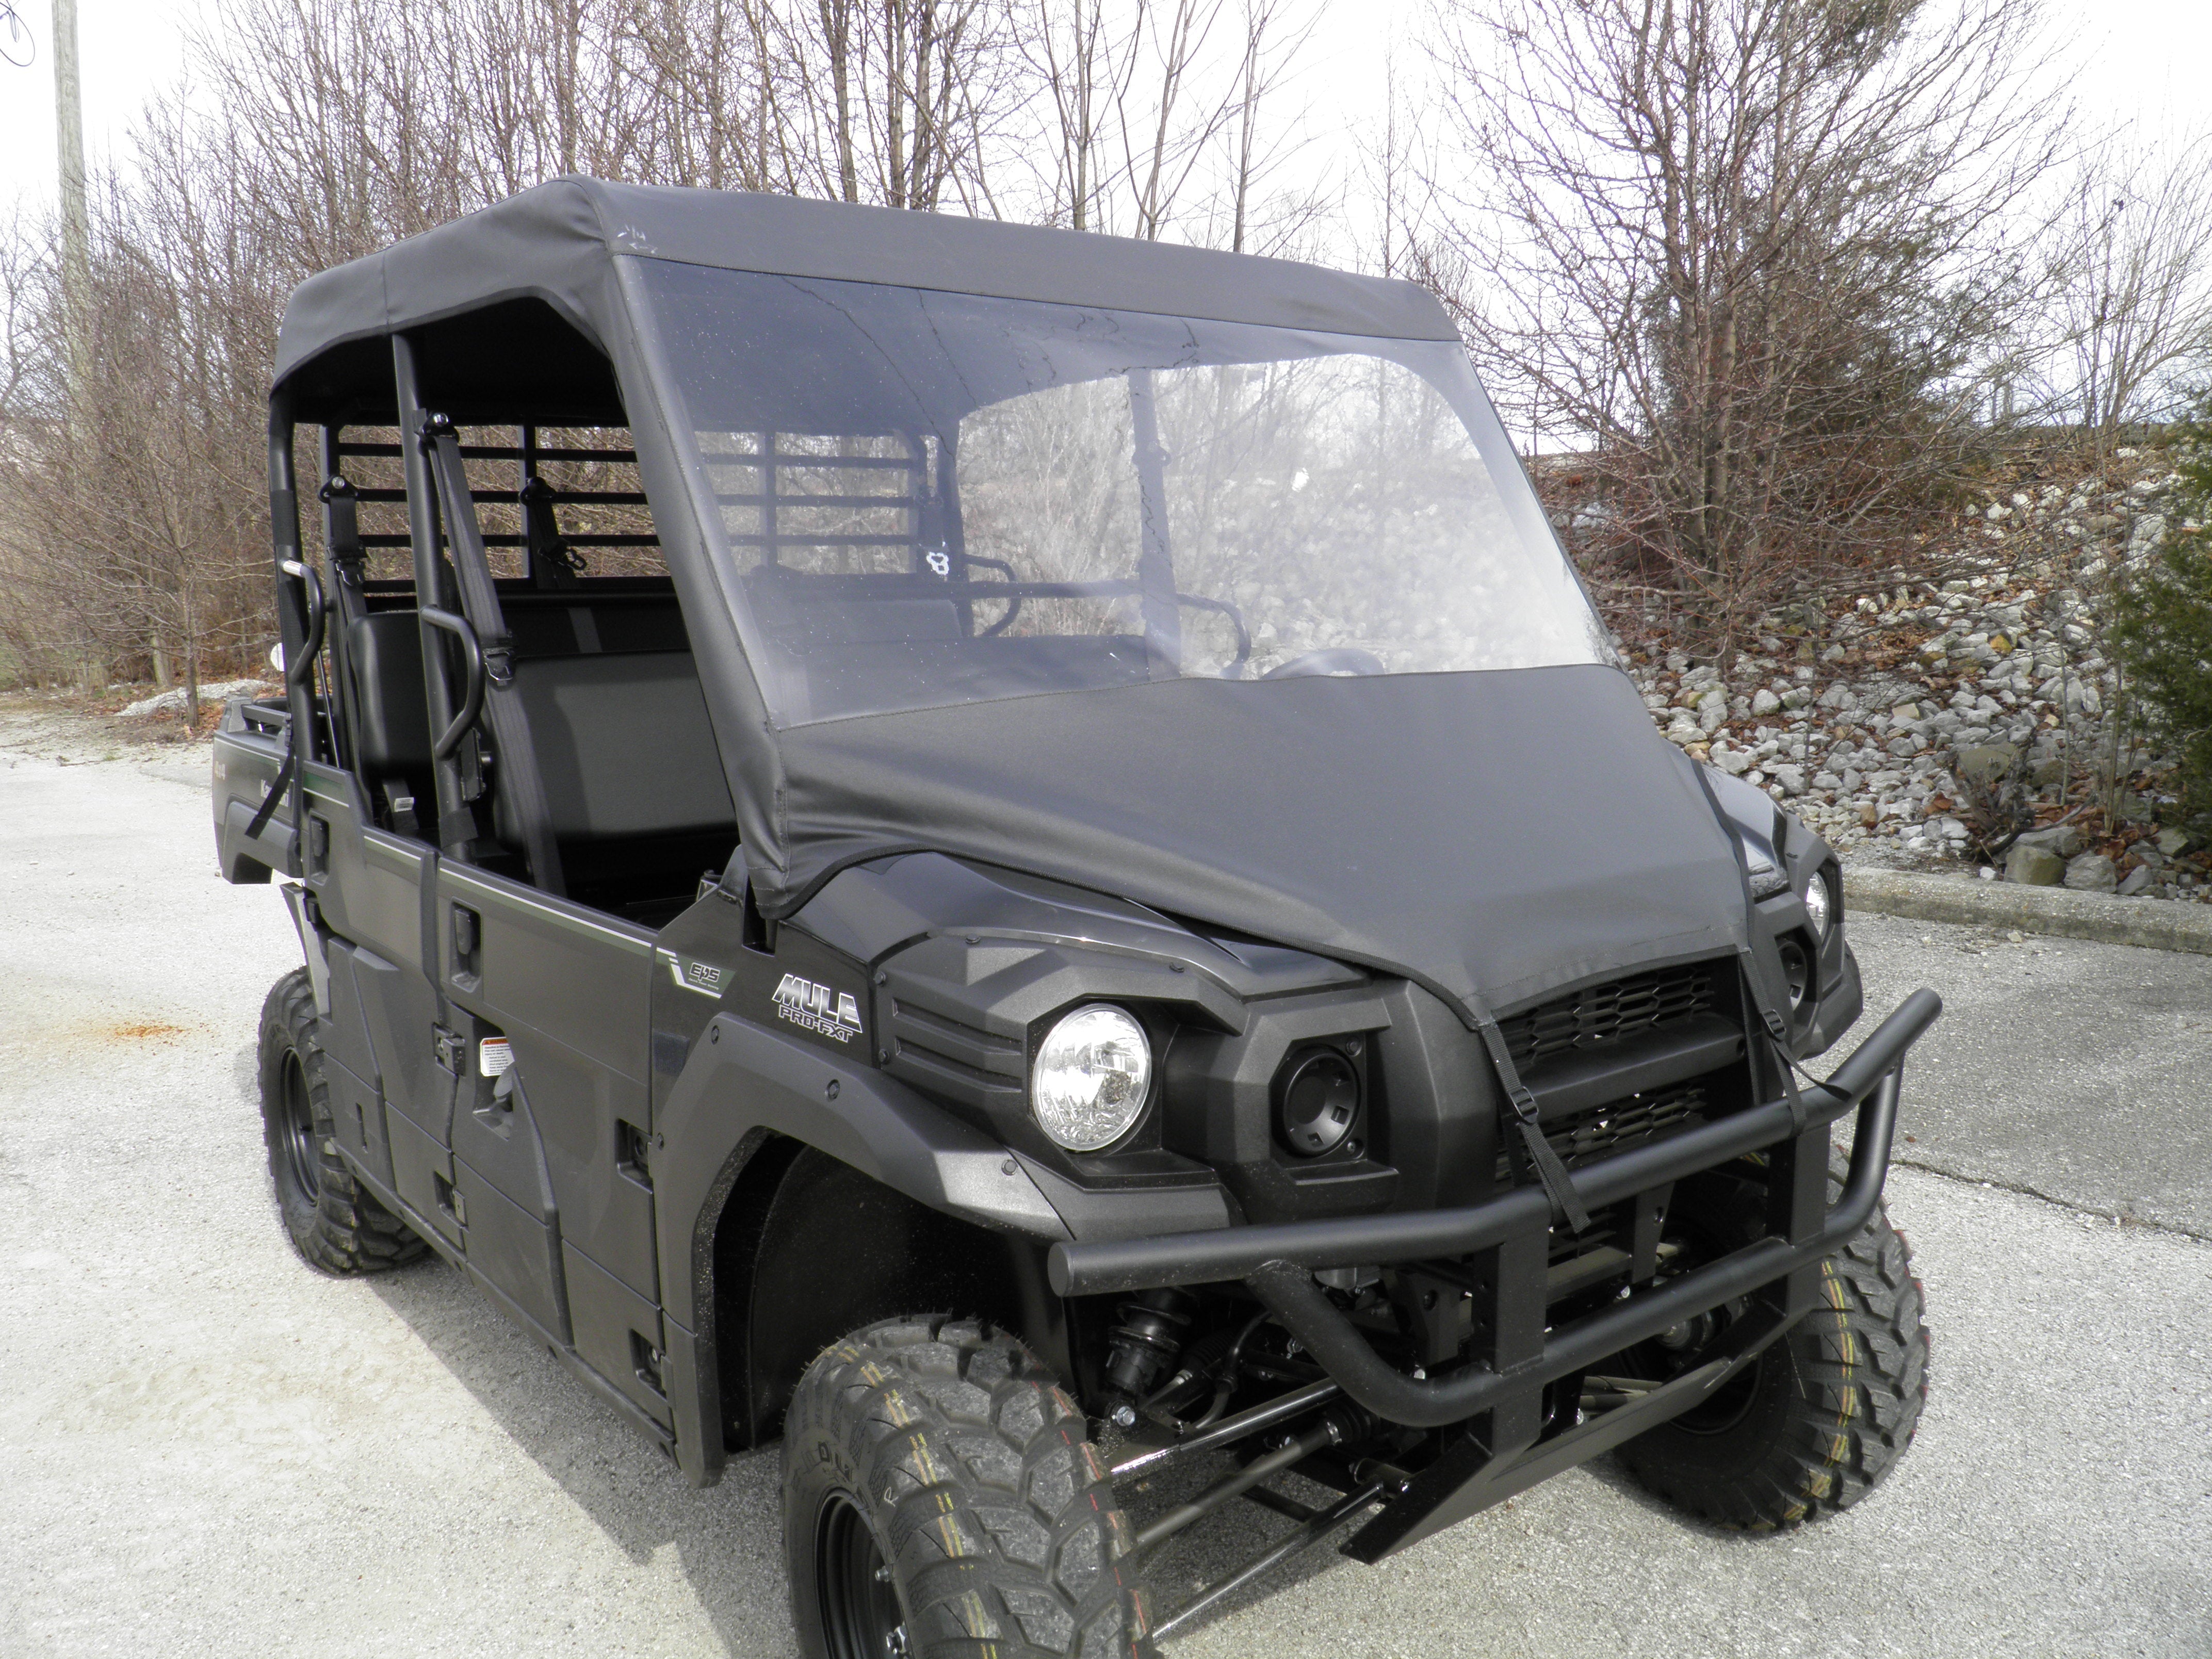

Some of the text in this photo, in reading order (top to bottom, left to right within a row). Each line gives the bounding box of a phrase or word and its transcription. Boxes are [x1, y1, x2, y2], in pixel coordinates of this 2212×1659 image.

[689, 962, 721, 982] EPS
[772, 973, 863, 1033] MULE
[778, 1004, 853, 1043] PRO-FXT
